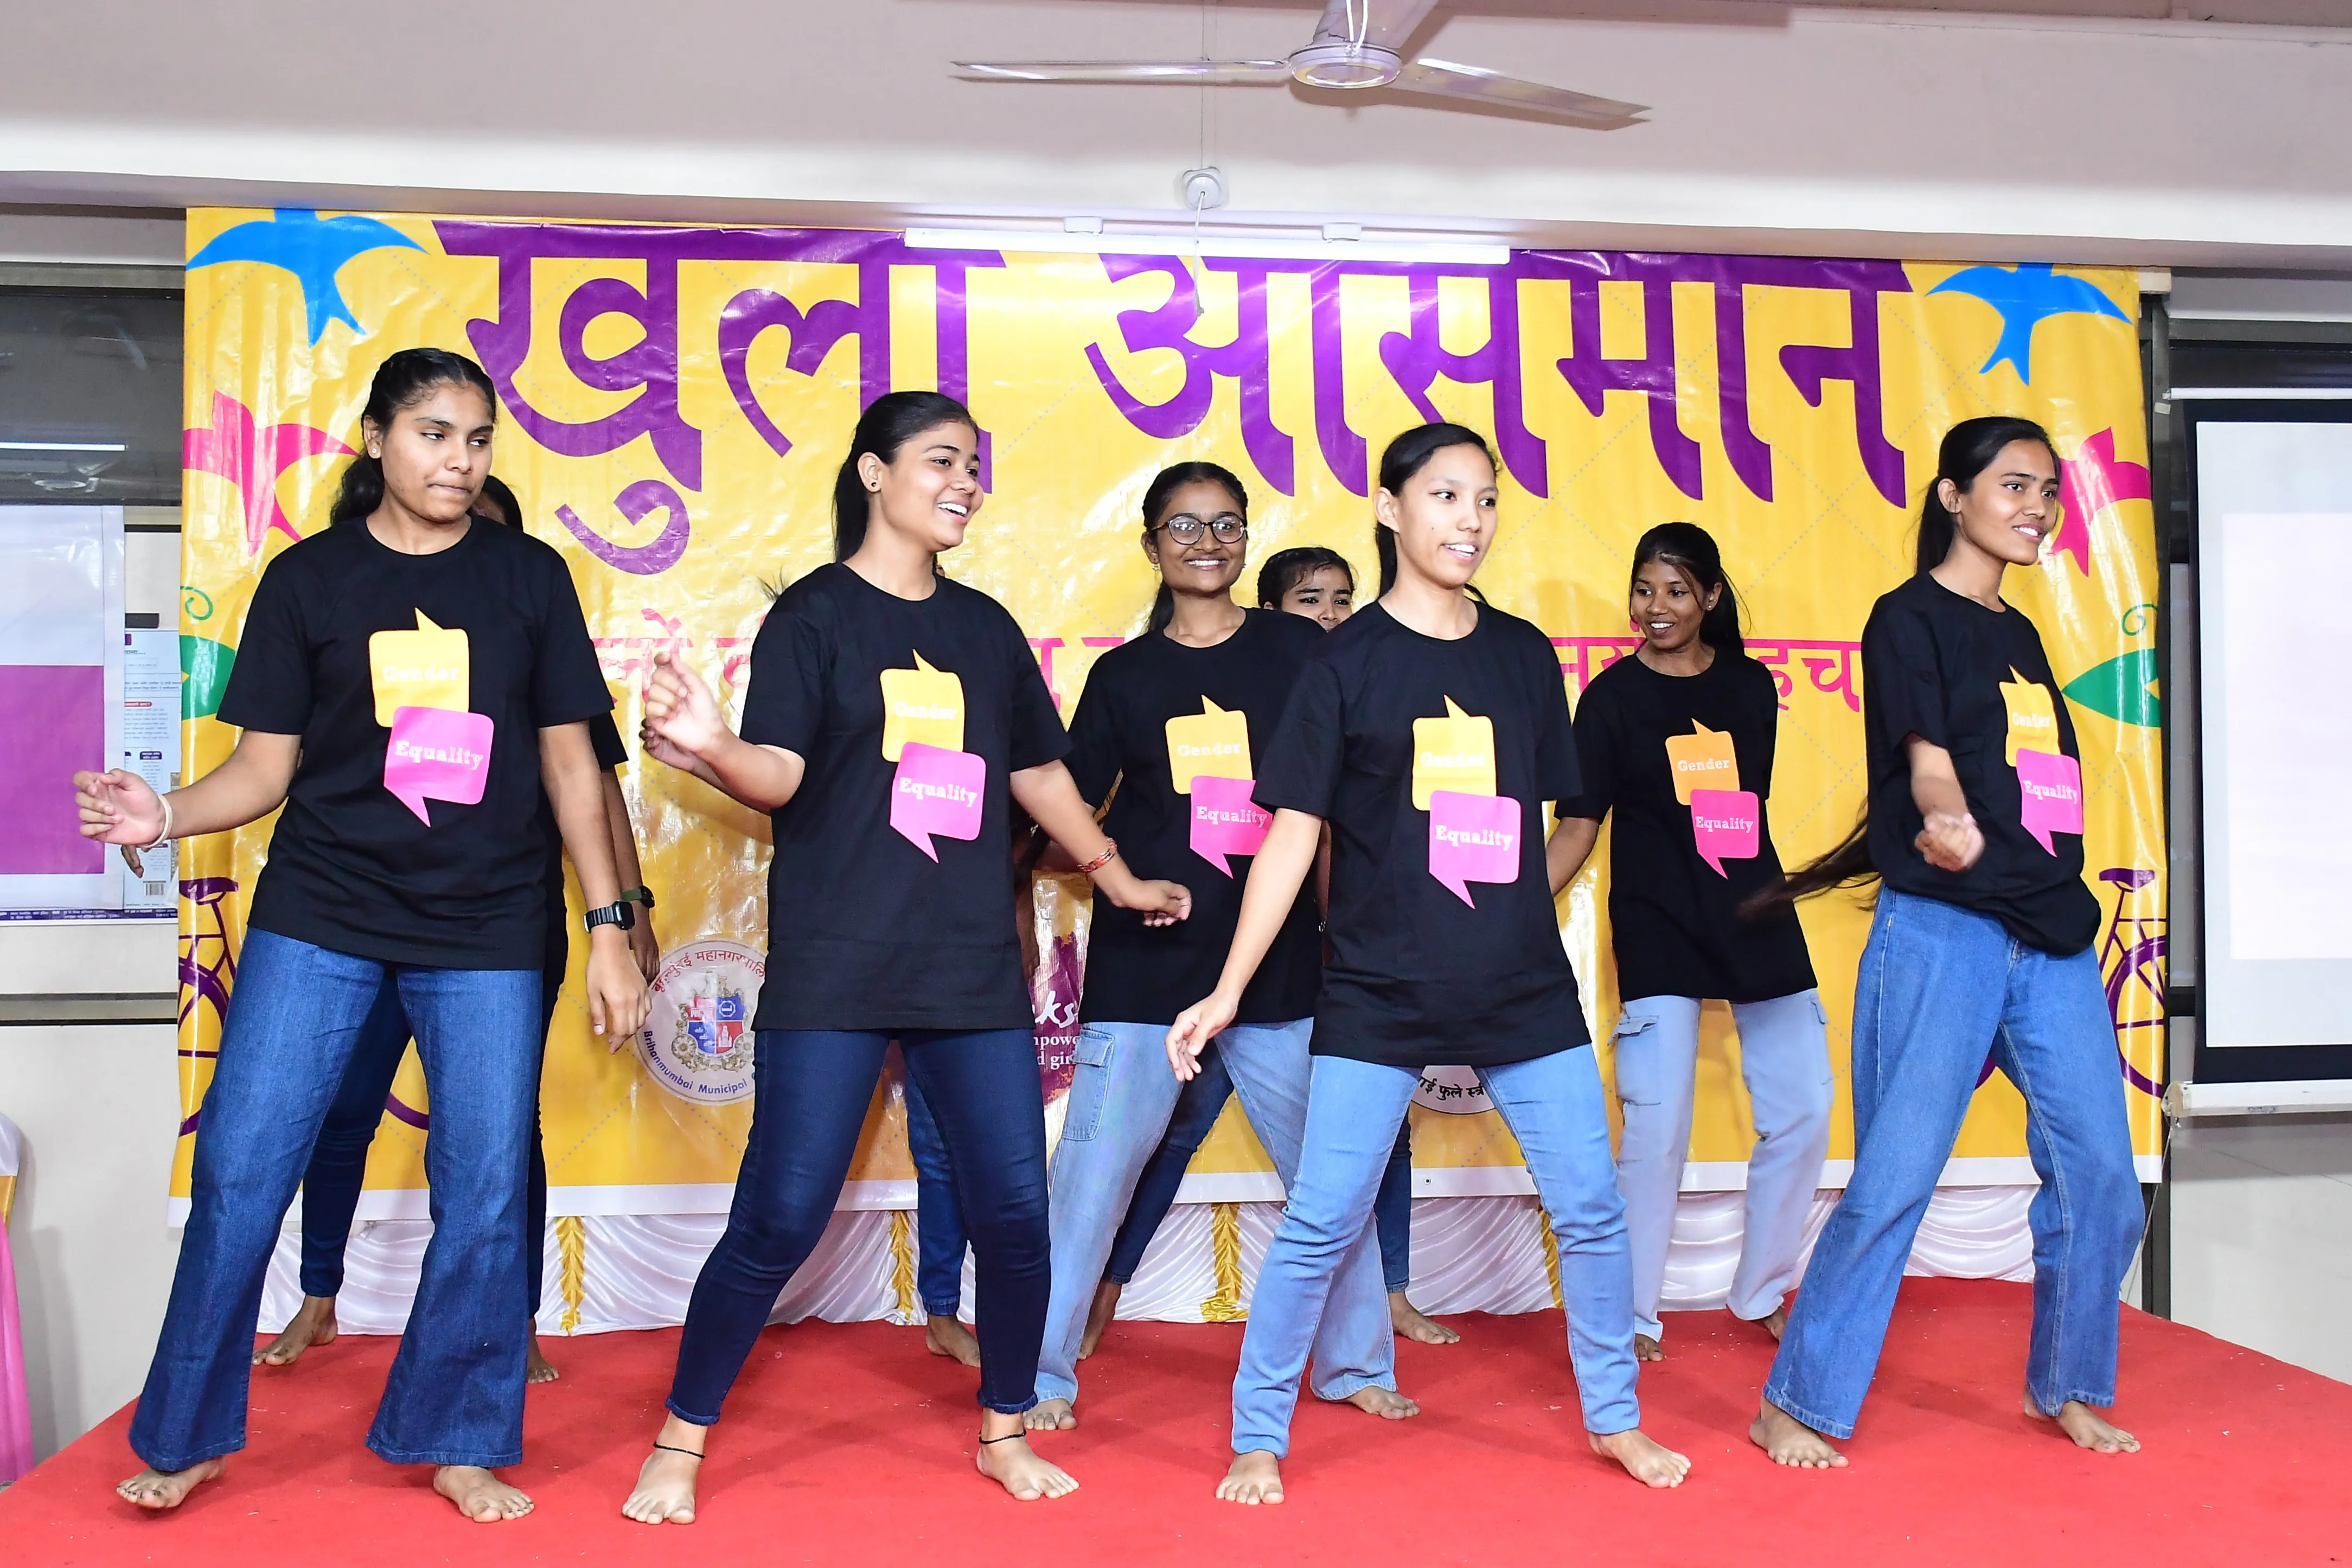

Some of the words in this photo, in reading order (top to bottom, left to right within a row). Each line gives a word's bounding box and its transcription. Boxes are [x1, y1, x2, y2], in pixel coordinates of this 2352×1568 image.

[433, 220, 1006, 575] खुला
[1084, 249, 1913, 509] आसमान
[382, 664, 461, 682] Gender
[894, 701, 957, 720] Gender
[395, 740, 484, 771] Equality
[1177, 742, 1241, 757] Gender
[1677, 758, 1730, 772] Gender
[898, 777, 977, 808] Equality
[2023, 780, 2078, 805] Equality
[1196, 806, 1268, 828] Equality
[1695, 816, 1754, 834] Equality
[1435, 824, 1513, 851] Equality
[695, 950, 765, 977] महानगरपालि
[643, 1031, 693, 1090] Brihanmumbai
[698, 1078, 747, 1094] Municipal
[1436, 1083, 1463, 1101] फुले
